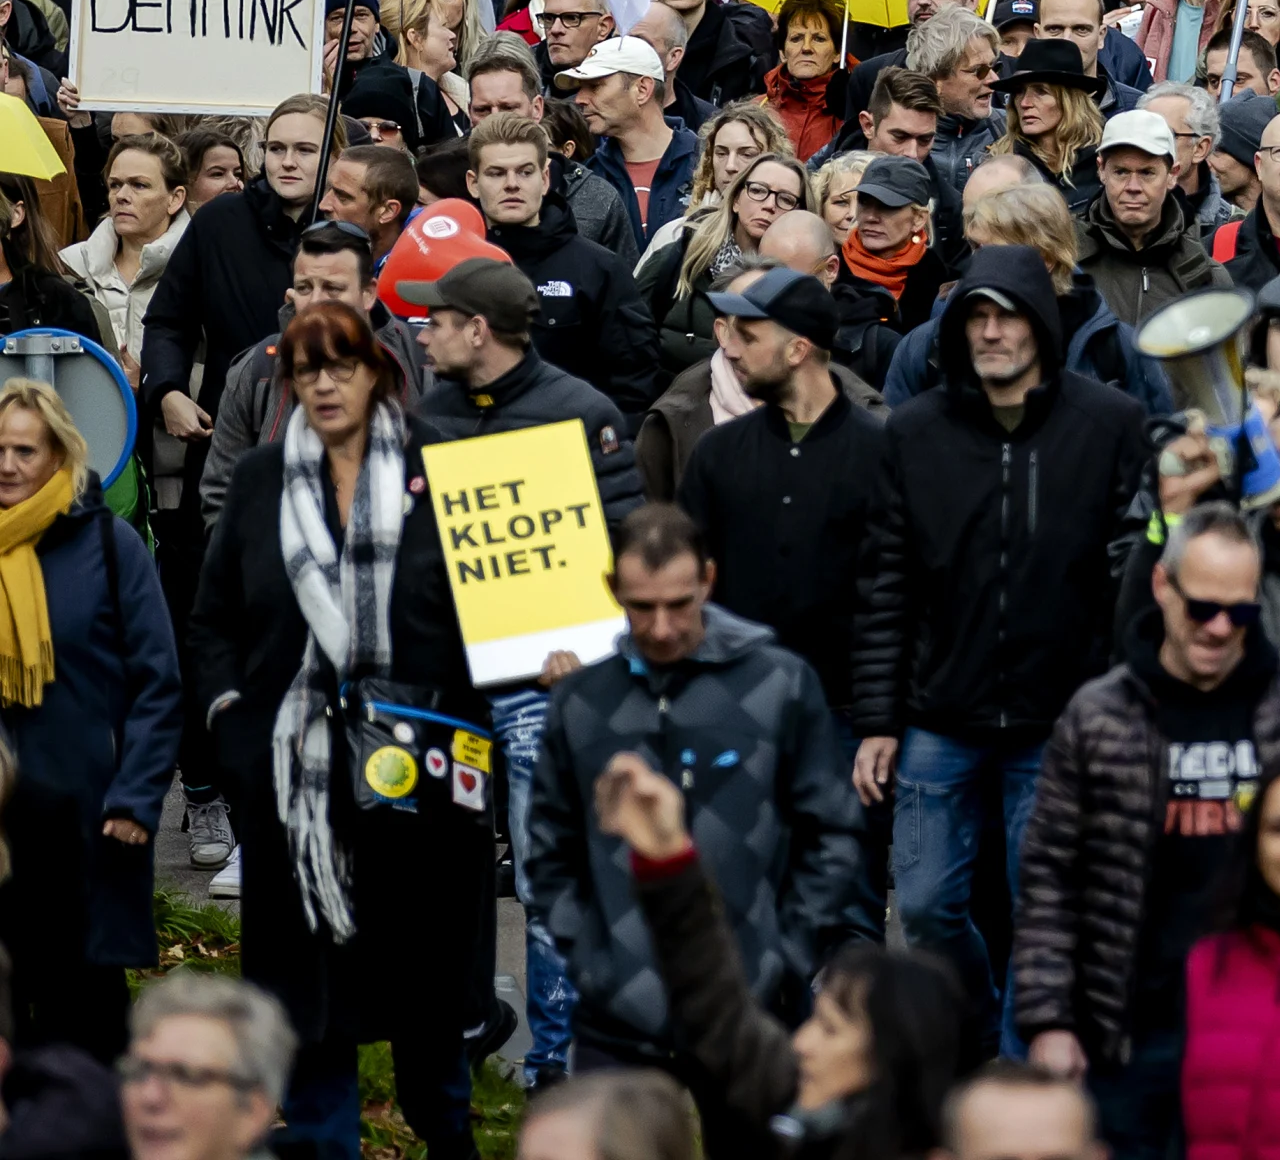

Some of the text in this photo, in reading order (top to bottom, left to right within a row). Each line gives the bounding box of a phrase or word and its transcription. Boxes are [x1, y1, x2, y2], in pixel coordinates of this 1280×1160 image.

[440, 479, 526, 517] HET
[449, 502, 591, 551] KLOPT
[455, 544, 567, 585] NIET.
